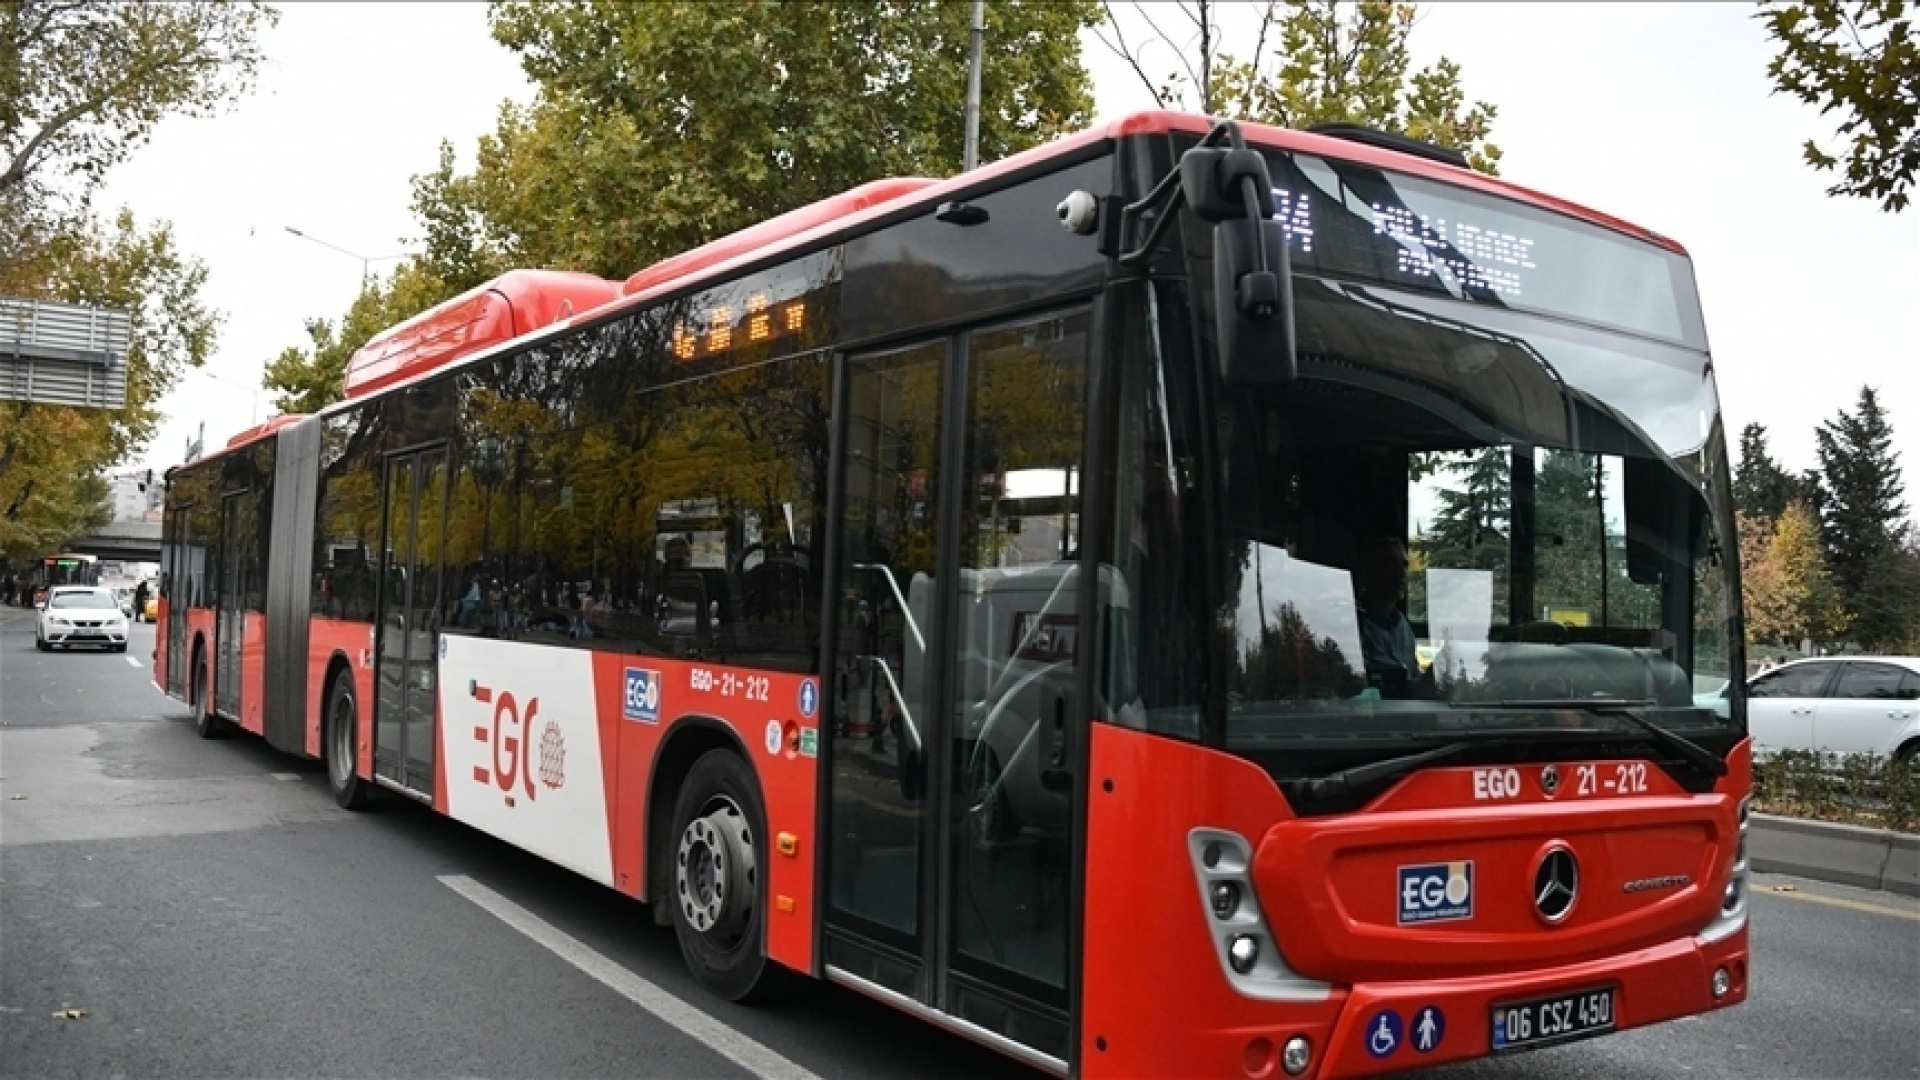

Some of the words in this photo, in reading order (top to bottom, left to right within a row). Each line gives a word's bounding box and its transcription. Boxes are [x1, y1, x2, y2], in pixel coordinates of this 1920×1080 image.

[626, 677, 660, 710] EGO
[1473, 768, 1521, 800] EGO
[1402, 874, 1469, 910] EGO
[1507, 1006, 1532, 1041] 06
[1539, 999, 1574, 1036] CSZ
[1579, 992, 1610, 1026] 450
